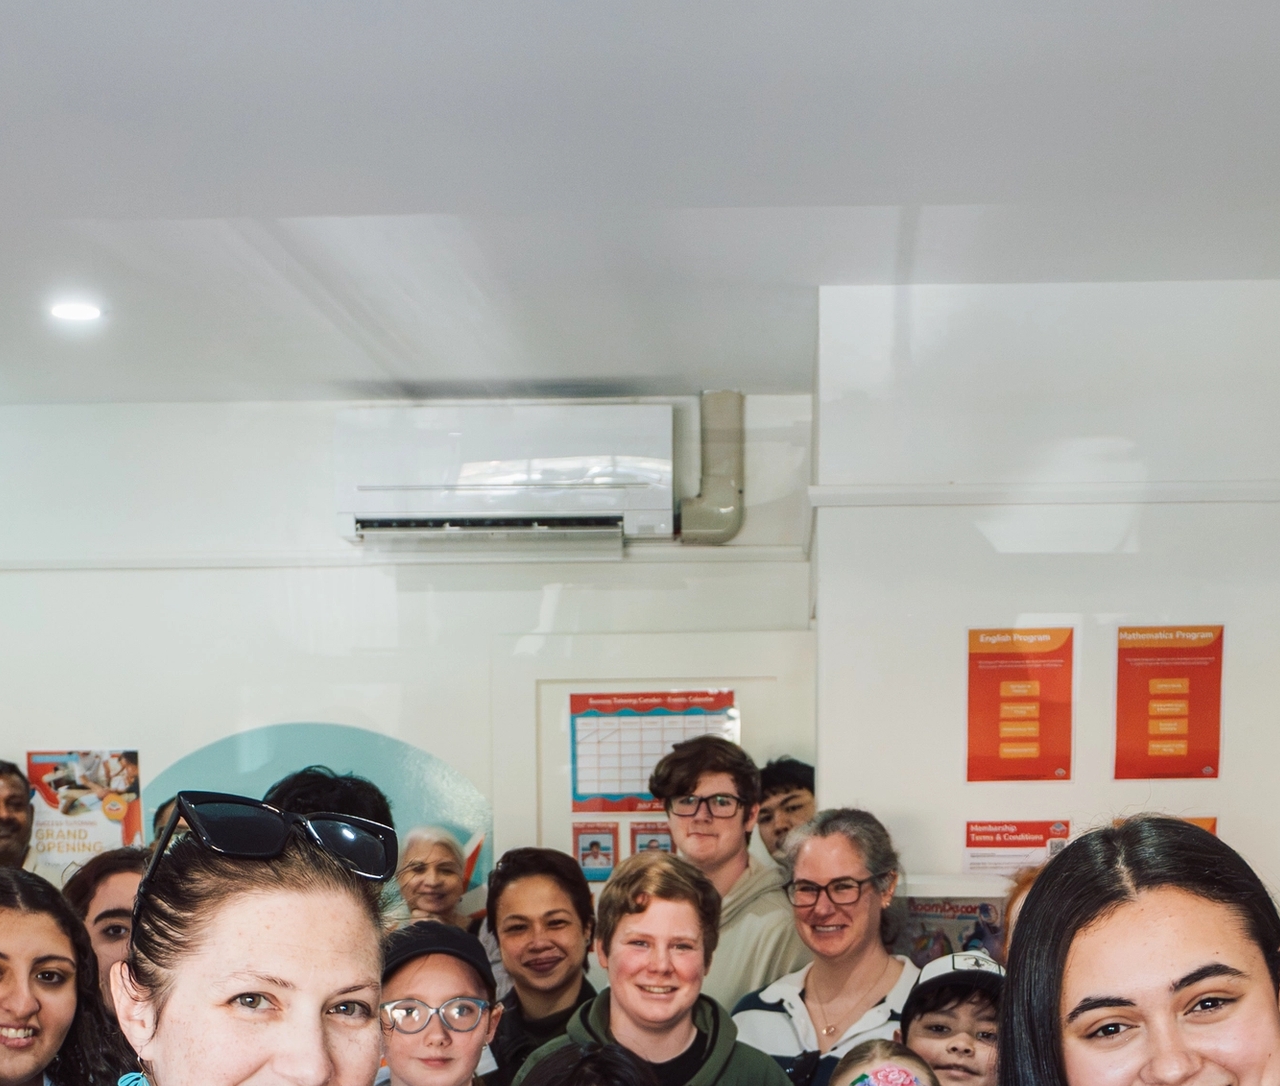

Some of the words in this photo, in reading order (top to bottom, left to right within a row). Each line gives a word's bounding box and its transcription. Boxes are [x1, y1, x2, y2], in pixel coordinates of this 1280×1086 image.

[979, 633, 1011, 644] English
[1013, 632, 1051, 643] Program
[1119, 630, 1173, 640] Mathematics
[1175, 630, 1214, 641] Program
[35, 828, 88, 841] GRAND
[970, 824, 1017, 834] Membership
[970, 833, 993, 842] Terms
[995, 834, 1002, 842] &
[1003, 832, 1044, 842] Conditions
[35, 841, 103, 853] OPENING
